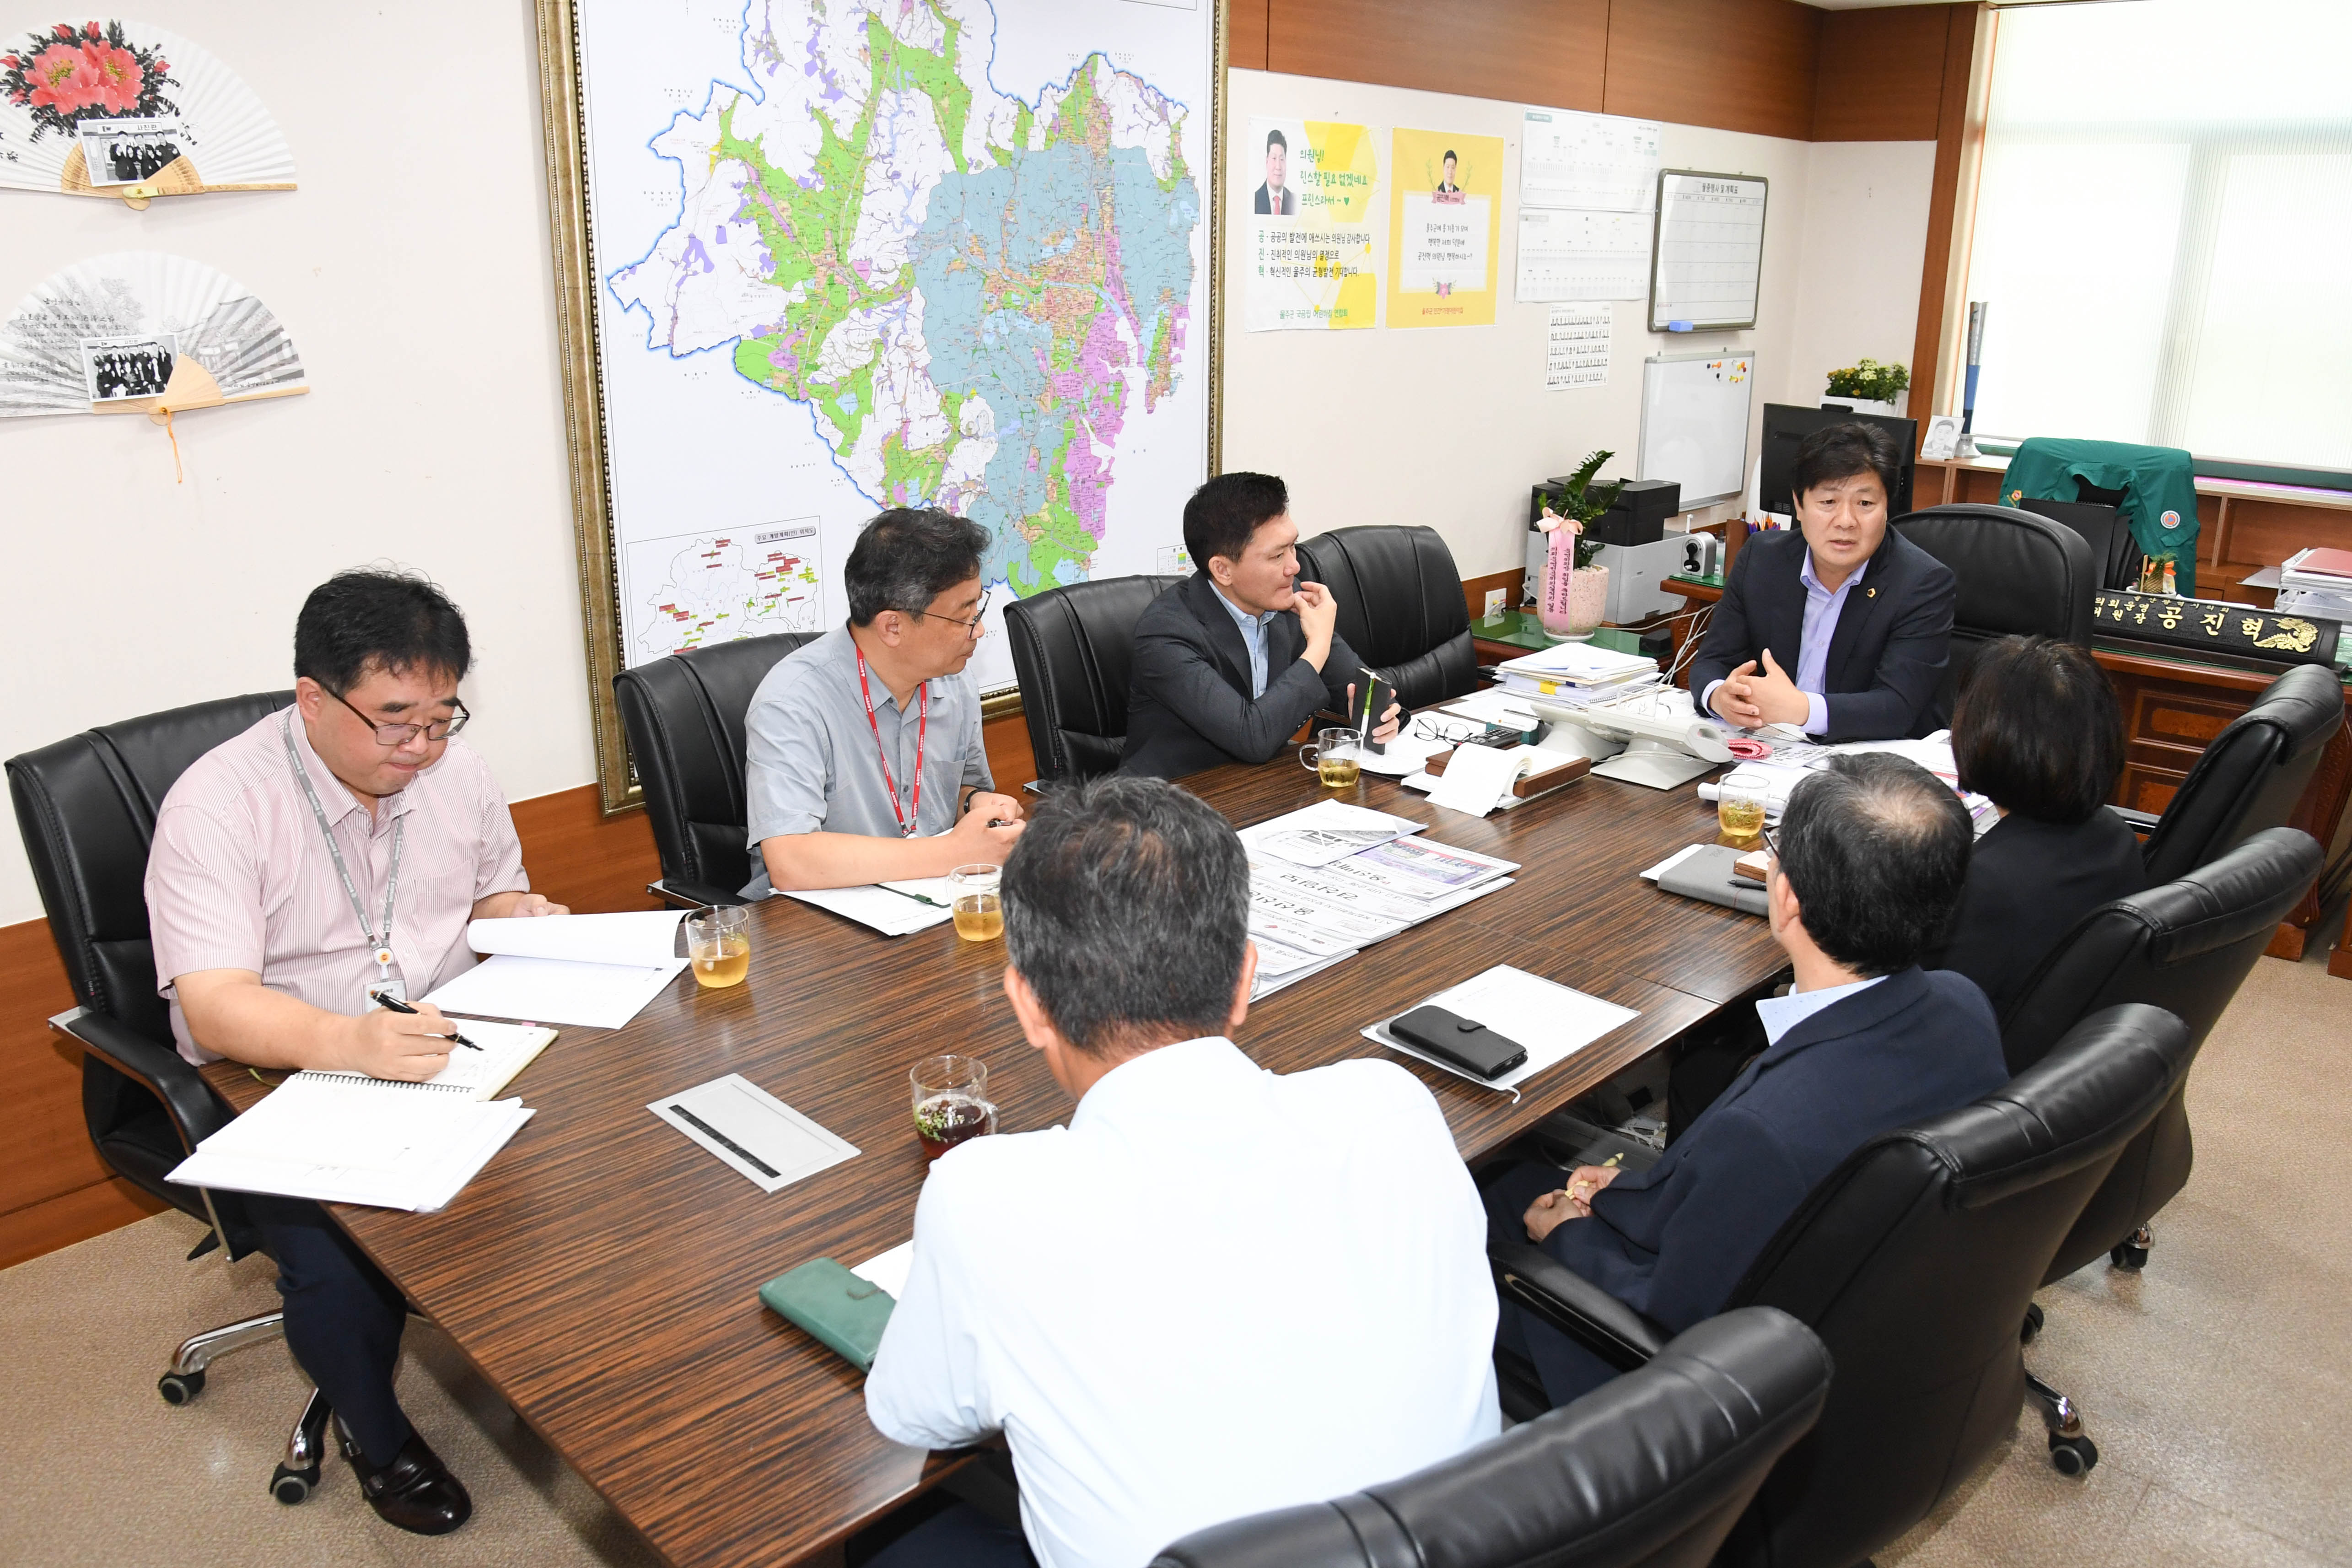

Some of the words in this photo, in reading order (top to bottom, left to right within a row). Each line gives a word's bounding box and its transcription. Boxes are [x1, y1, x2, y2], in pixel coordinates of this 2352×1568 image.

[1300, 149, 1324, 163] 의원님!
[1300, 171, 1321, 186] 린스할
[1323, 172, 1336, 187] 필요
[1339, 173, 1367, 187] 없겠네요
[1302, 194, 1335, 206] 프린스라서
[1258, 230, 1264, 243] 공
[1270, 232, 1287, 242] 공공의
[1289, 232, 1307, 243] 발전에
[1309, 232, 1330, 243] 애쓰시는
[1331, 233, 1345, 243] 의원님
[1347, 233, 1370, 244] 감사합니다
[1259, 248, 1264, 260] 진
[1270, 250, 1292, 260] 진취적인
[1294, 250, 1318, 261] 의원님의
[1319, 250, 1339, 261] 열정으로
[1258, 265, 1264, 278] 혁
[1270, 266, 1291, 277] 혁신적인
[1293, 267, 1311, 278] 울주의
[1280, 310, 1294, 319] 울주군
[1297, 309, 1311, 318] 국공립
[1313, 309, 1332, 318] 어린이집
[2094, 597, 2149, 613] 의회운영
[2158, 606, 2264, 641] 공진혁
[1280, 873, 1358, 901] 경상일보
